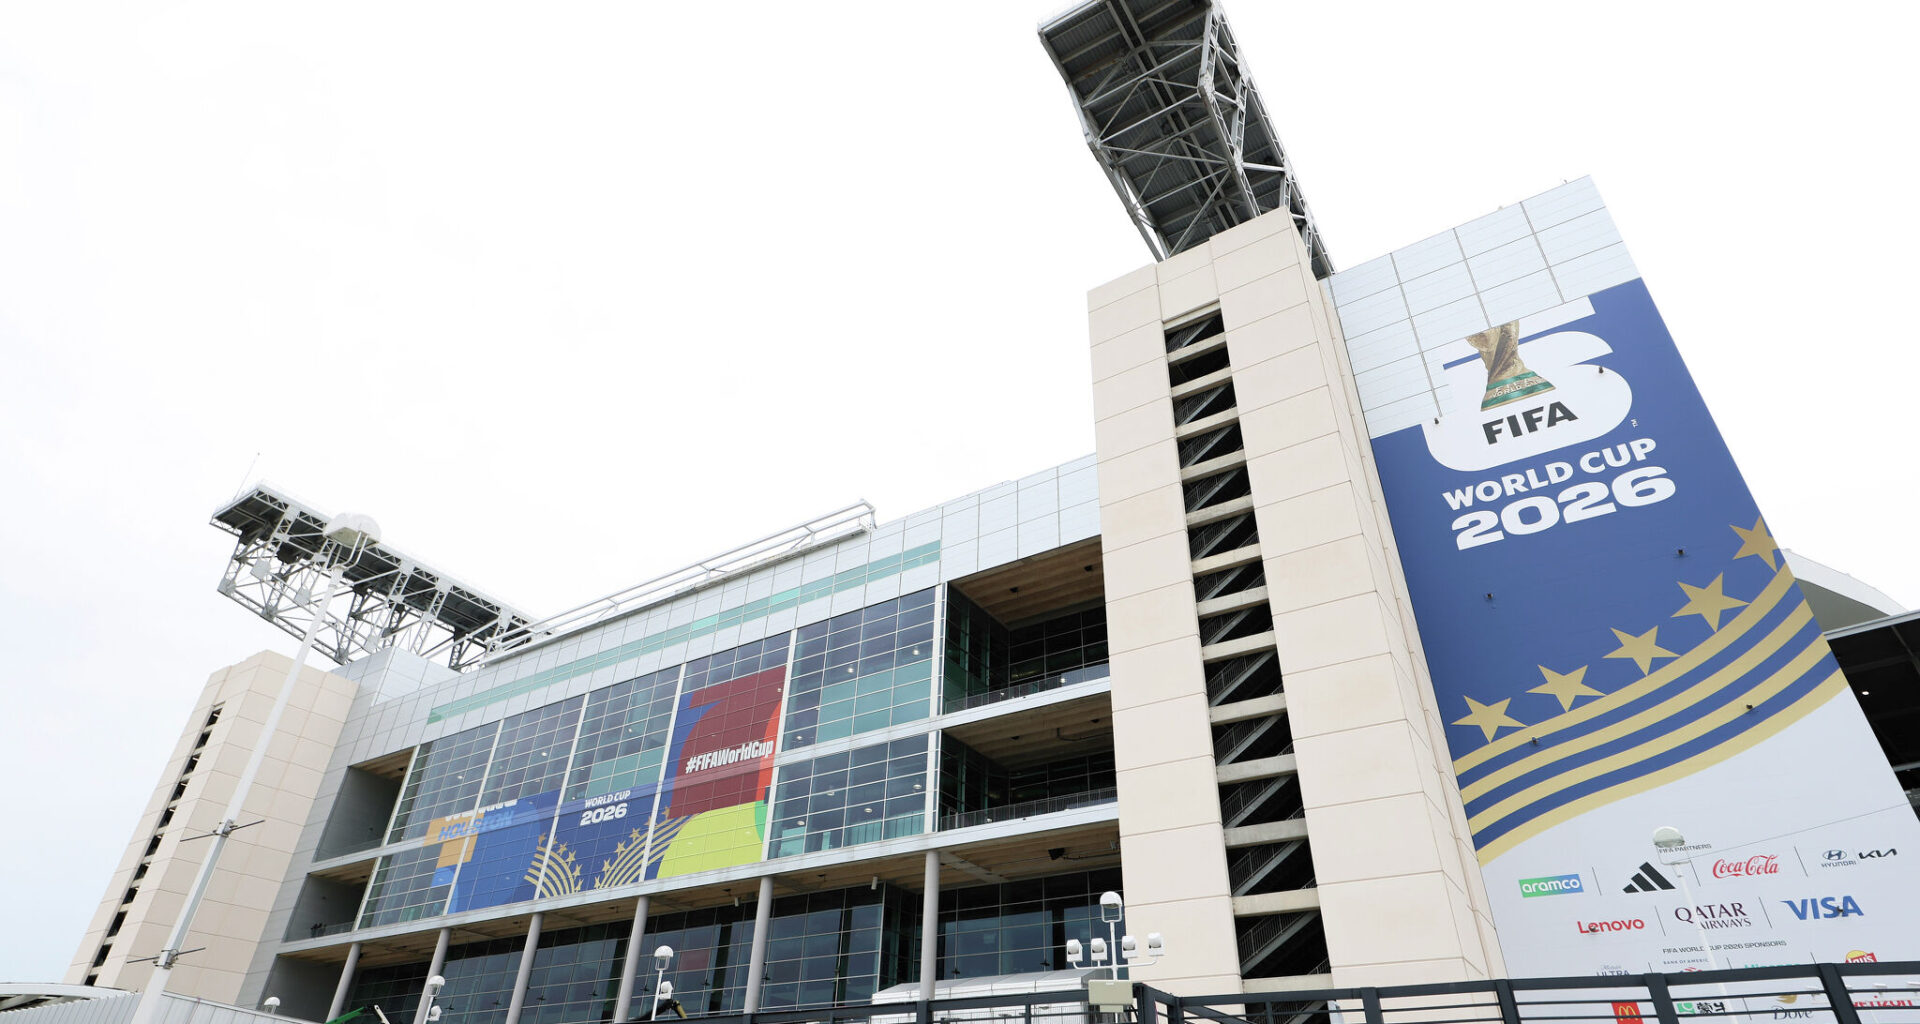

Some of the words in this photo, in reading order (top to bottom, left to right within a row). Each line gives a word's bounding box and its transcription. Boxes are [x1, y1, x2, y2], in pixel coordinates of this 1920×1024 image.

[1482, 401, 1579, 445] FIFA
[1442, 462, 1573, 511] WORLD
[1580, 438, 1656, 473] CUP
[1451, 466, 1677, 551] 2026
[685, 740, 774, 774] #FIFAWorldCup
[585, 793, 613, 809] WORLD
[614, 789, 631, 802] CUP
[580, 802, 628, 827] 2026
[1821, 860, 1857, 868] HYUNDAI
[1522, 878, 1581, 893] aramco
[1674, 902, 1748, 924] QATAR
[1780, 895, 1865, 921] VISA
[1577, 919, 1645, 934] Lenovo
[1700, 917, 1752, 930] AIRWAYS
[1744, 940, 1788, 949] SPONSORS
